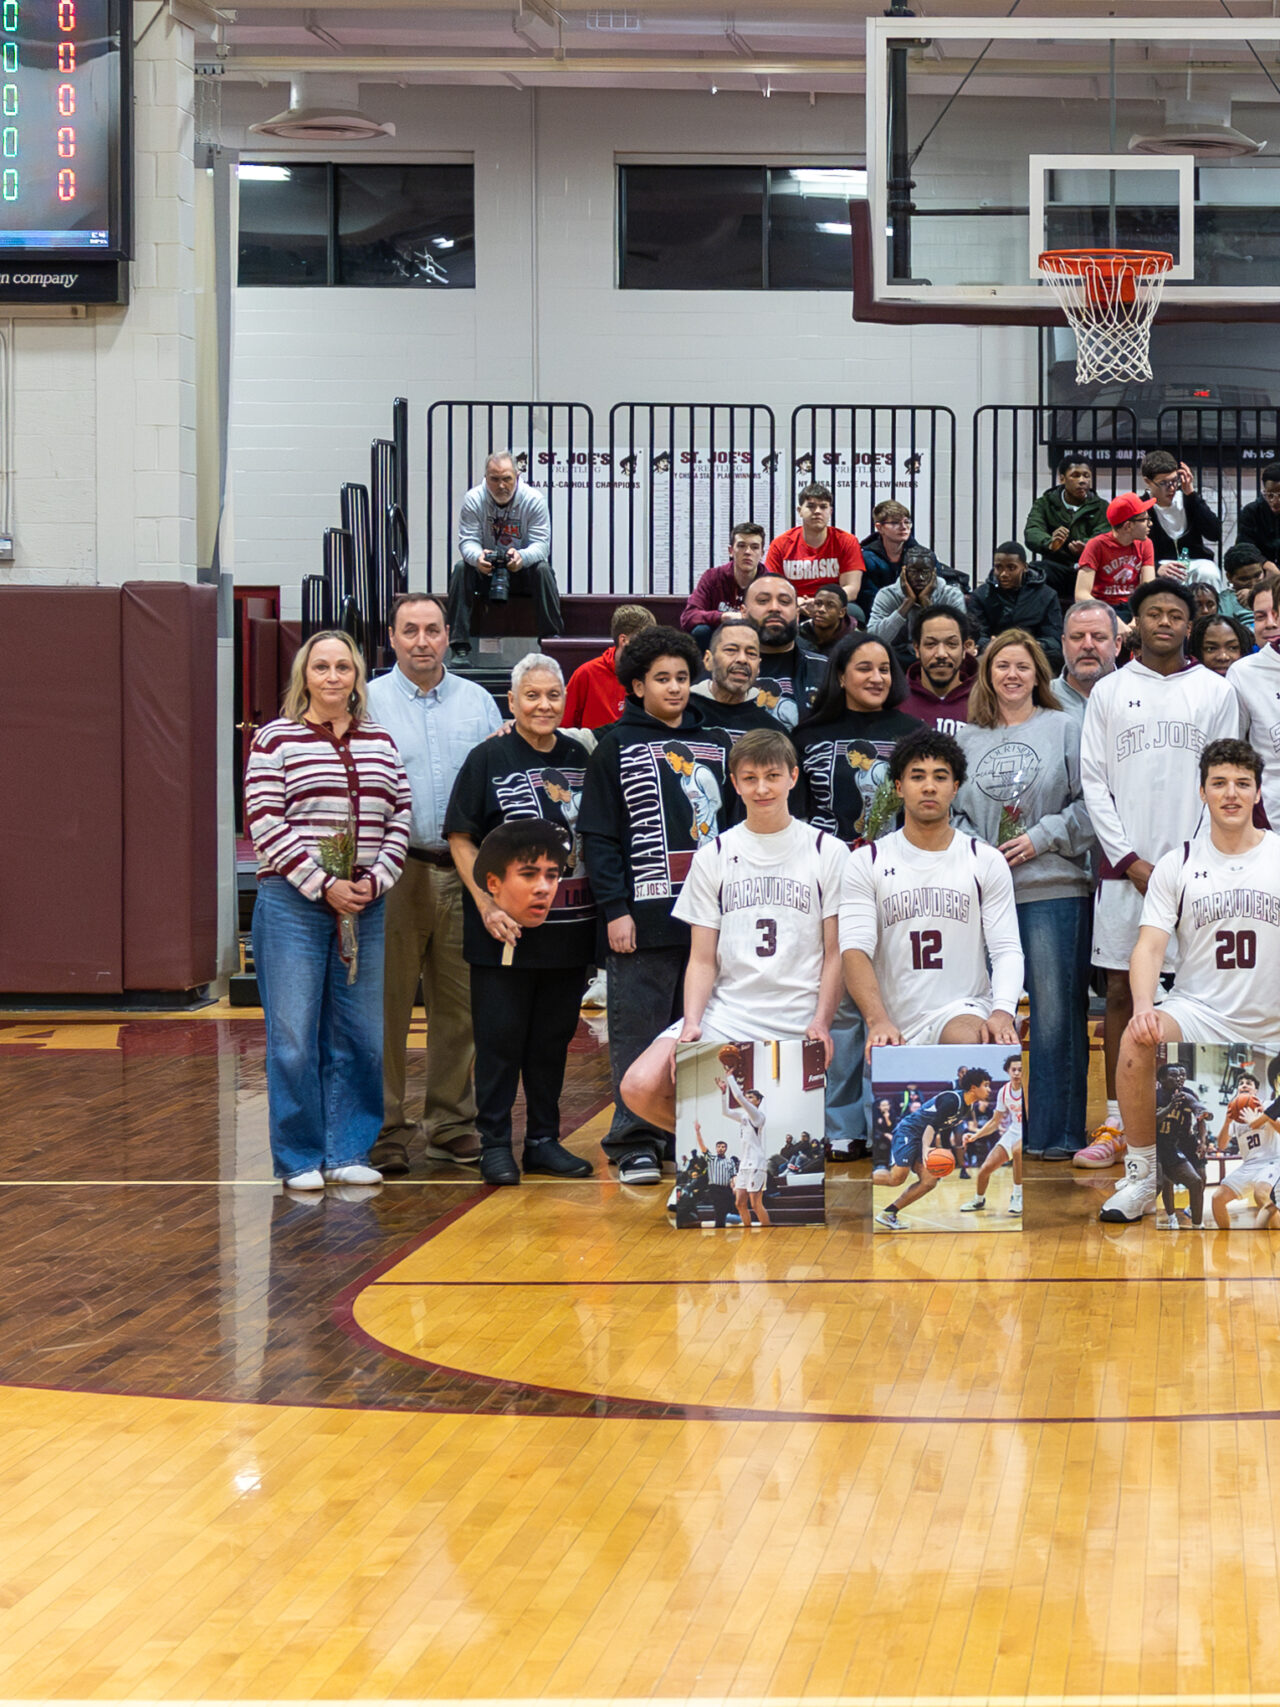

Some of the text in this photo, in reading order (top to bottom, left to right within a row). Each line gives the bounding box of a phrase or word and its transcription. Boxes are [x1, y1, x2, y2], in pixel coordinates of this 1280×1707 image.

[58, 0, 75, 31] 0
[58, 42, 75, 72] 0
[58, 84, 75, 115] 0
[58, 127, 75, 157] 0
[58, 168, 75, 200] 0
[13, 273, 79, 288] company
[538, 452, 561, 465] ST.
[680, 451, 702, 464] ST.
[822, 452, 846, 465] ST.
[1116, 724, 1151, 762] ST.
[620, 743, 667, 882] MARAUDERS
[647, 882, 668, 896] JOE'S
[883, 887, 970, 929] MARAUDERS
[1192, 888, 1280, 930] MARAUDERS
[755, 918, 777, 958] 3
[909, 929, 943, 970] 12
[1215, 930, 1256, 970] 20
[1246, 1133, 1261, 1150] 20
